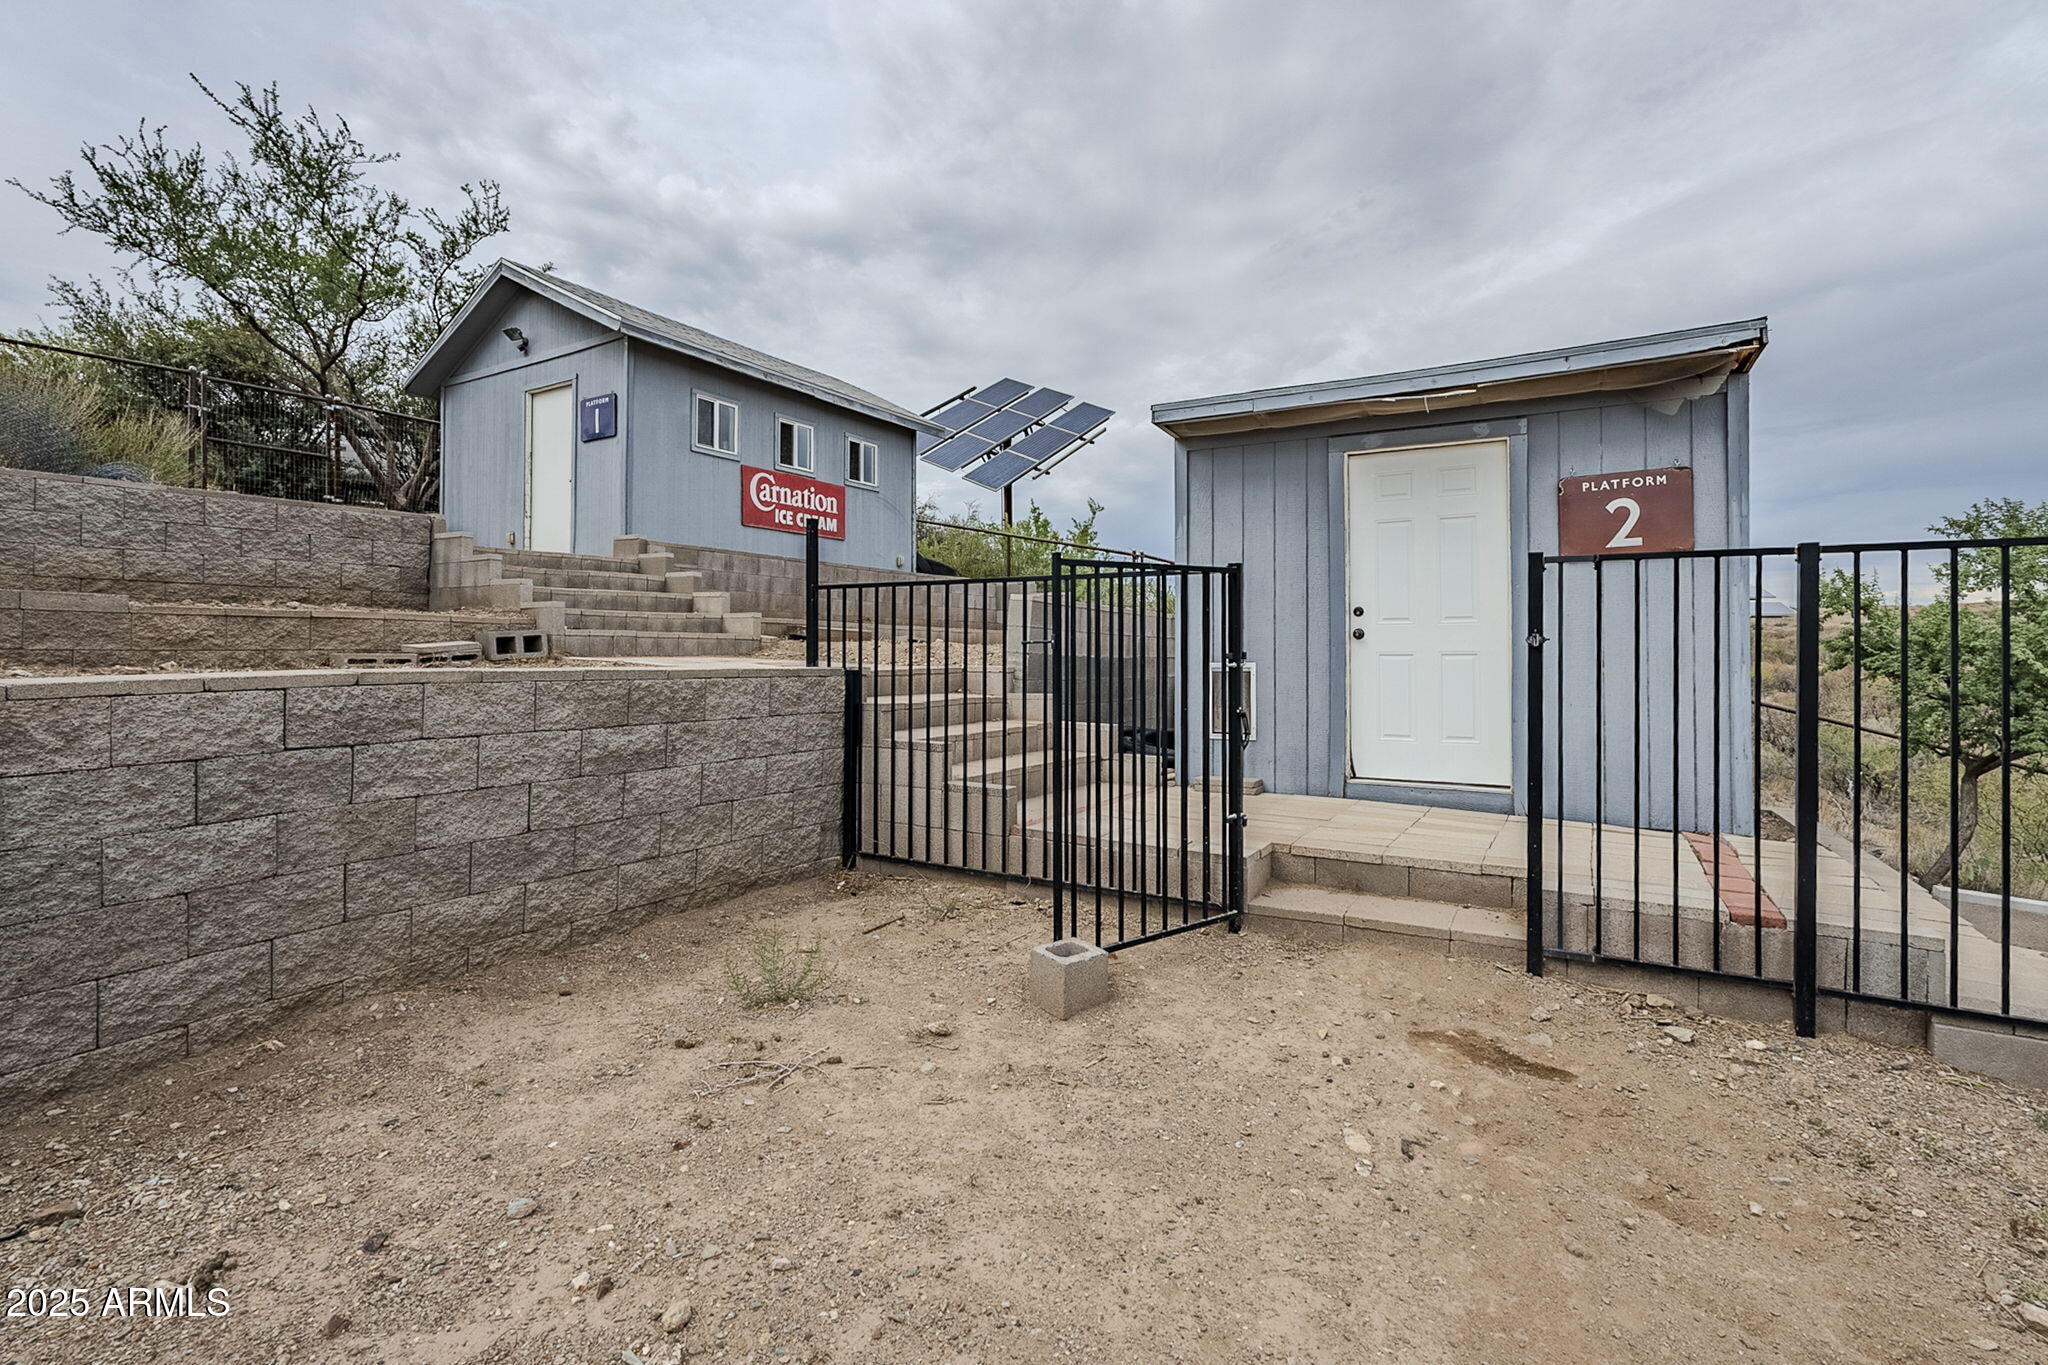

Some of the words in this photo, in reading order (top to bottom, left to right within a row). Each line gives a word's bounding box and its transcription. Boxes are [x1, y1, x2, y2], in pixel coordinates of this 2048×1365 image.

[585, 397, 609, 407] PLATFORM
[1582, 475, 1667, 492] PLATFORM
[749, 472, 838, 514] Carnation
[774, 509, 794, 526] ICE
[1605, 497, 1643, 549] 2
